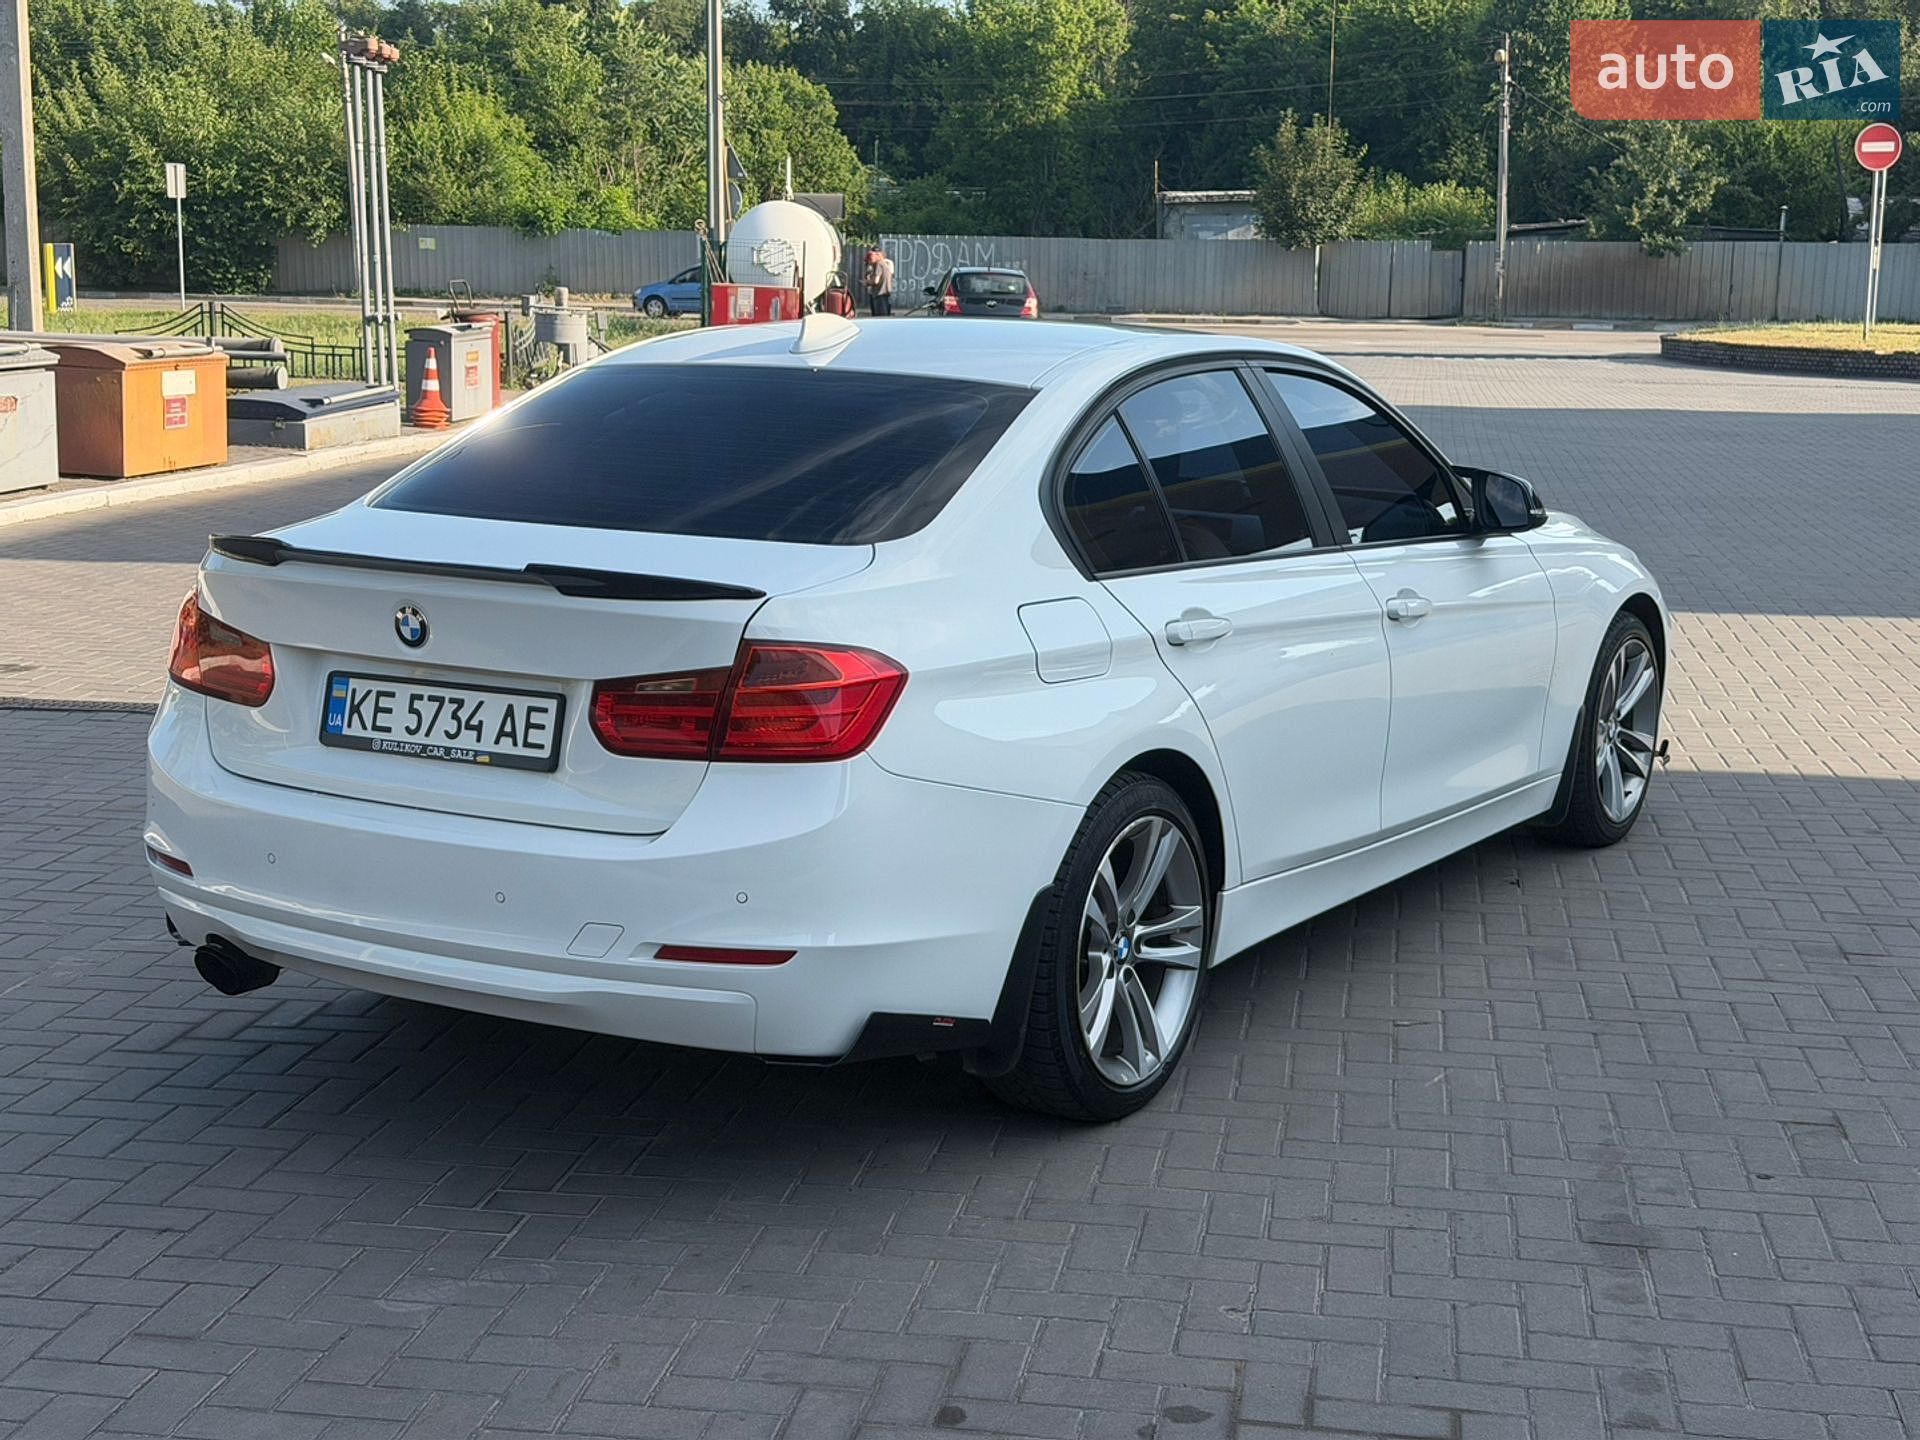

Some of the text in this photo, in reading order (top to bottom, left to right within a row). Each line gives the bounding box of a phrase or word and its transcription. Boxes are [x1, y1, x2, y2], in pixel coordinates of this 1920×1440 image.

[328, 712, 342, 726] UA
[347, 688, 549, 750] KE 5734 AE
